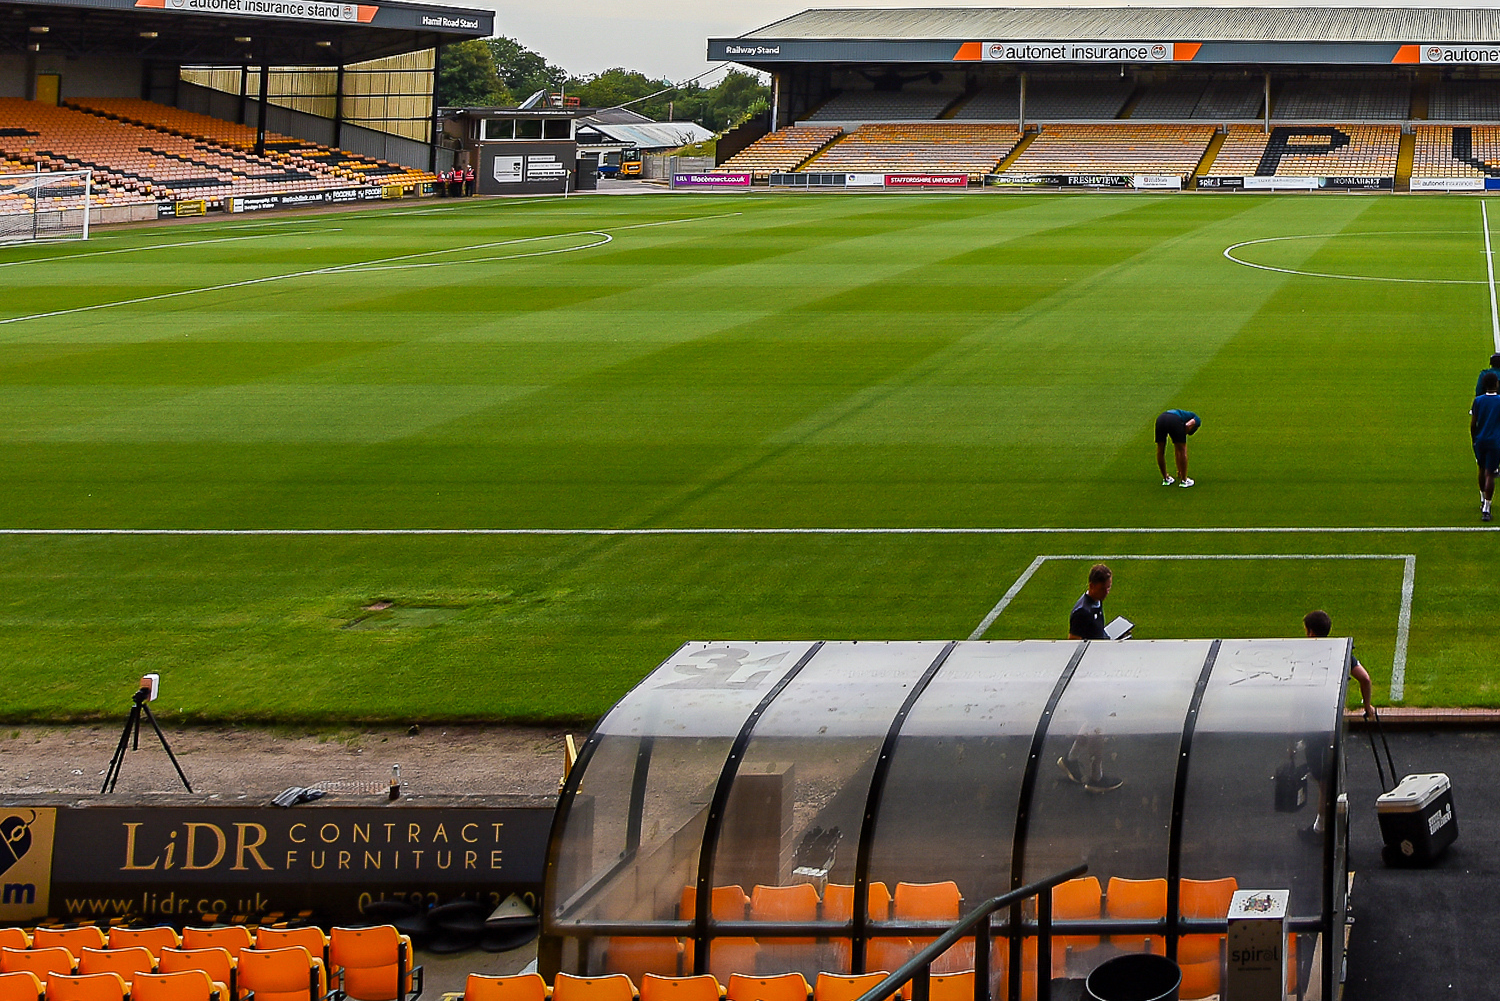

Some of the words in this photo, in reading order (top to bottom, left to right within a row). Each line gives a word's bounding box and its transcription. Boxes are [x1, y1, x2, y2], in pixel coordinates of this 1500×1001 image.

[307, 1, 340, 18] stand
[443, 18, 459, 28] Road
[460, 19, 478, 29] Stand
[726, 45, 756, 56] Railway
[757, 45, 780, 55] Stand
[1006, 44, 1067, 60] autonet
[1070, 44, 1148, 60] insurance
[1255, 126, 1351, 177] P
[1333, 177, 1381, 185] IRONMARKET
[289, 823, 504, 843] CONTRACT
[120, 822, 274, 871] LiDR
[287, 850, 503, 870] FURNITURE
[65, 891, 269, 915] www.lidr.co.uk
[1232, 945, 1279, 965] spiral
